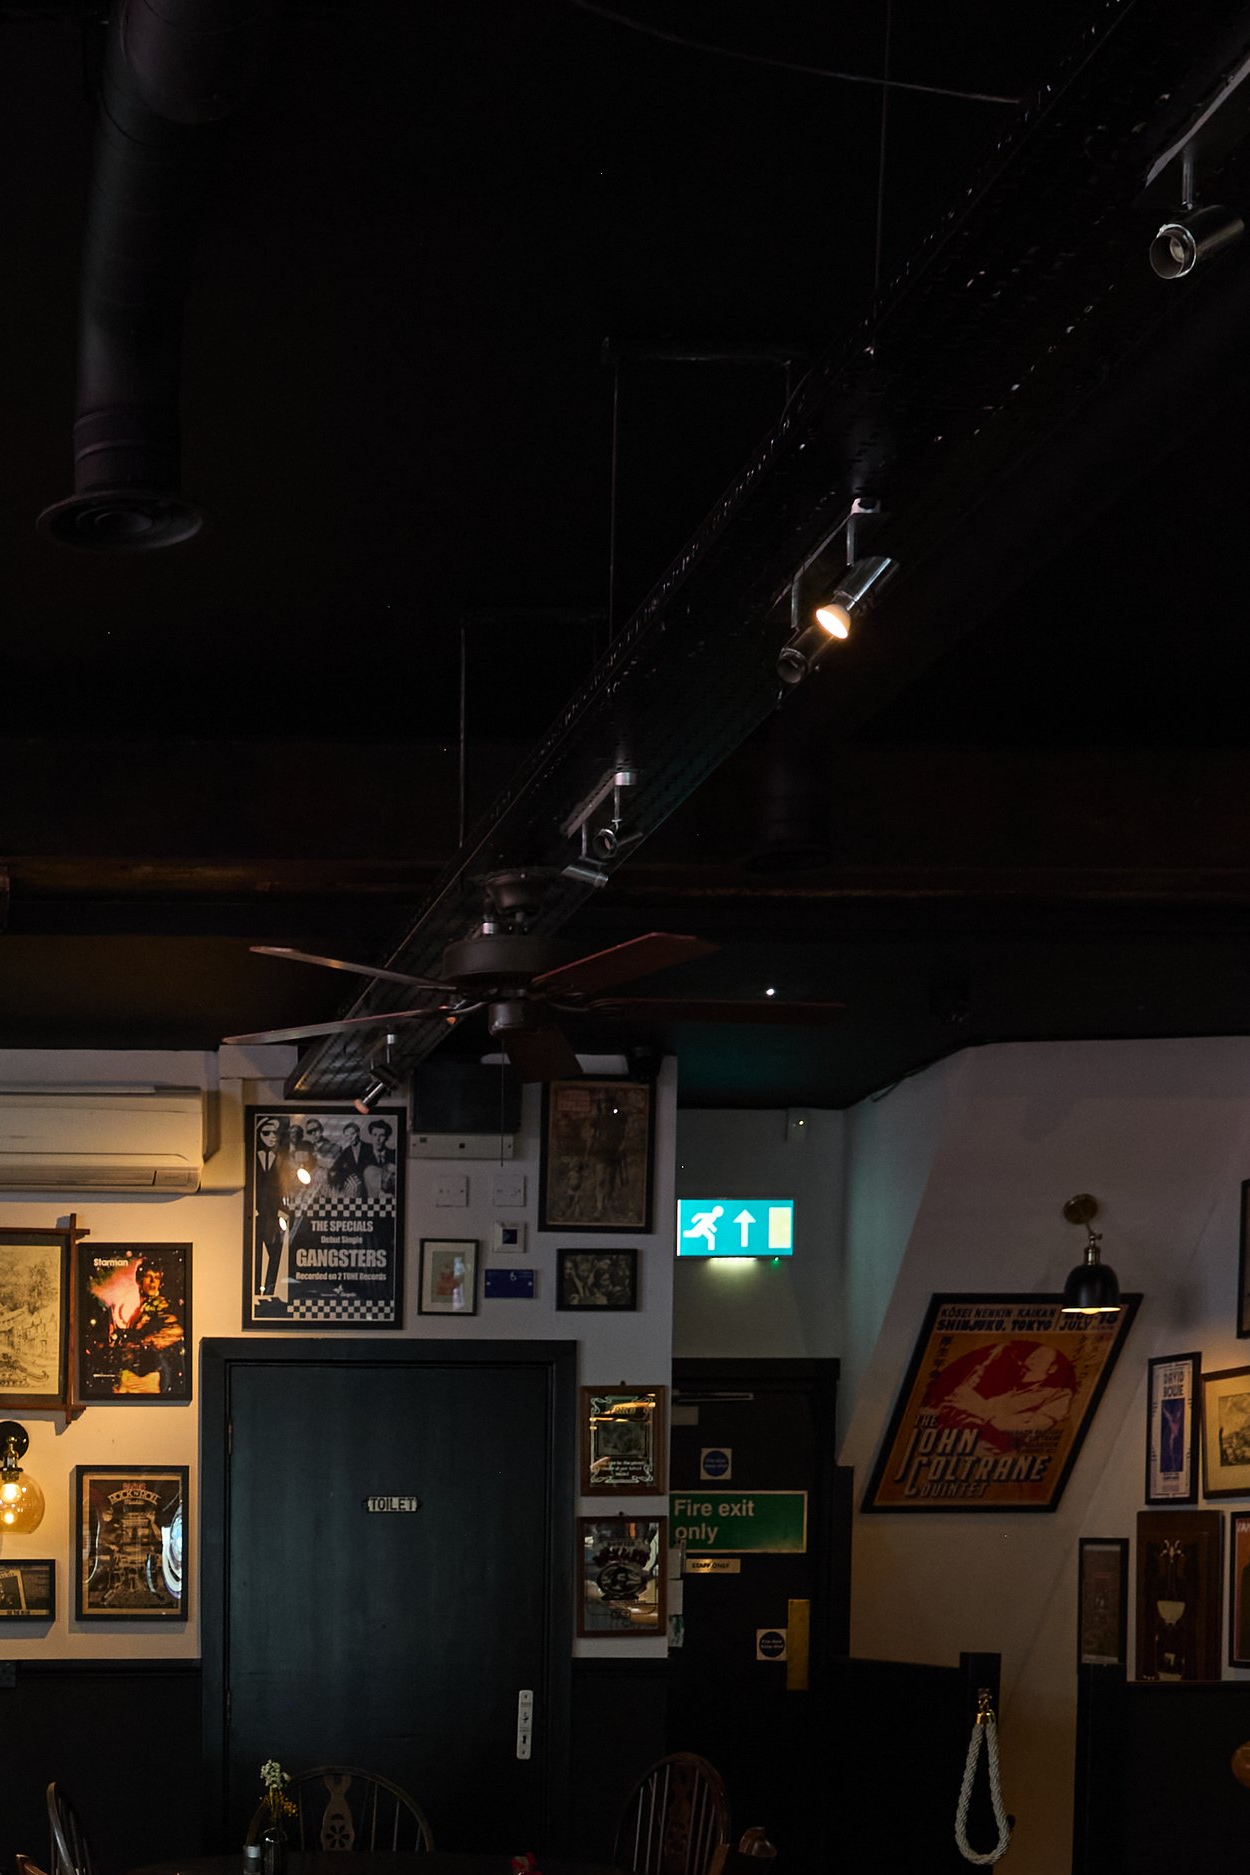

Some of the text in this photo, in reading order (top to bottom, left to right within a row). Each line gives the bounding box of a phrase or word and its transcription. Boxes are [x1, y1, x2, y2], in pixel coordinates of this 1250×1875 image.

[311, 1220, 374, 1233] THE SPECIALS
[320, 1235, 364, 1246] Debut Single
[93, 1258, 129, 1268] Starman
[296, 1248, 388, 1268] GANGSTERS
[295, 1271, 328, 1281] Recorded
[338, 1271, 344, 1281] 2
[360, 1271, 388, 1281] Records
[1017, 1308, 1057, 1319] KAIKAN
[1011, 1319, 1054, 1332] TOKYO
[1059, 1320, 1089, 1332] JULY
[1163, 1370, 1184, 1385] DAVID
[914, 1413, 940, 1428] THE
[893, 1428, 981, 1484] JOHN
[903, 1454, 1052, 1498] COLTRANE
[920, 1482, 991, 1498] QUINTET
[370, 1498, 415, 1511] TOILET
[673, 1499, 755, 1517] Fire exit
[674, 1524, 719, 1545] only
